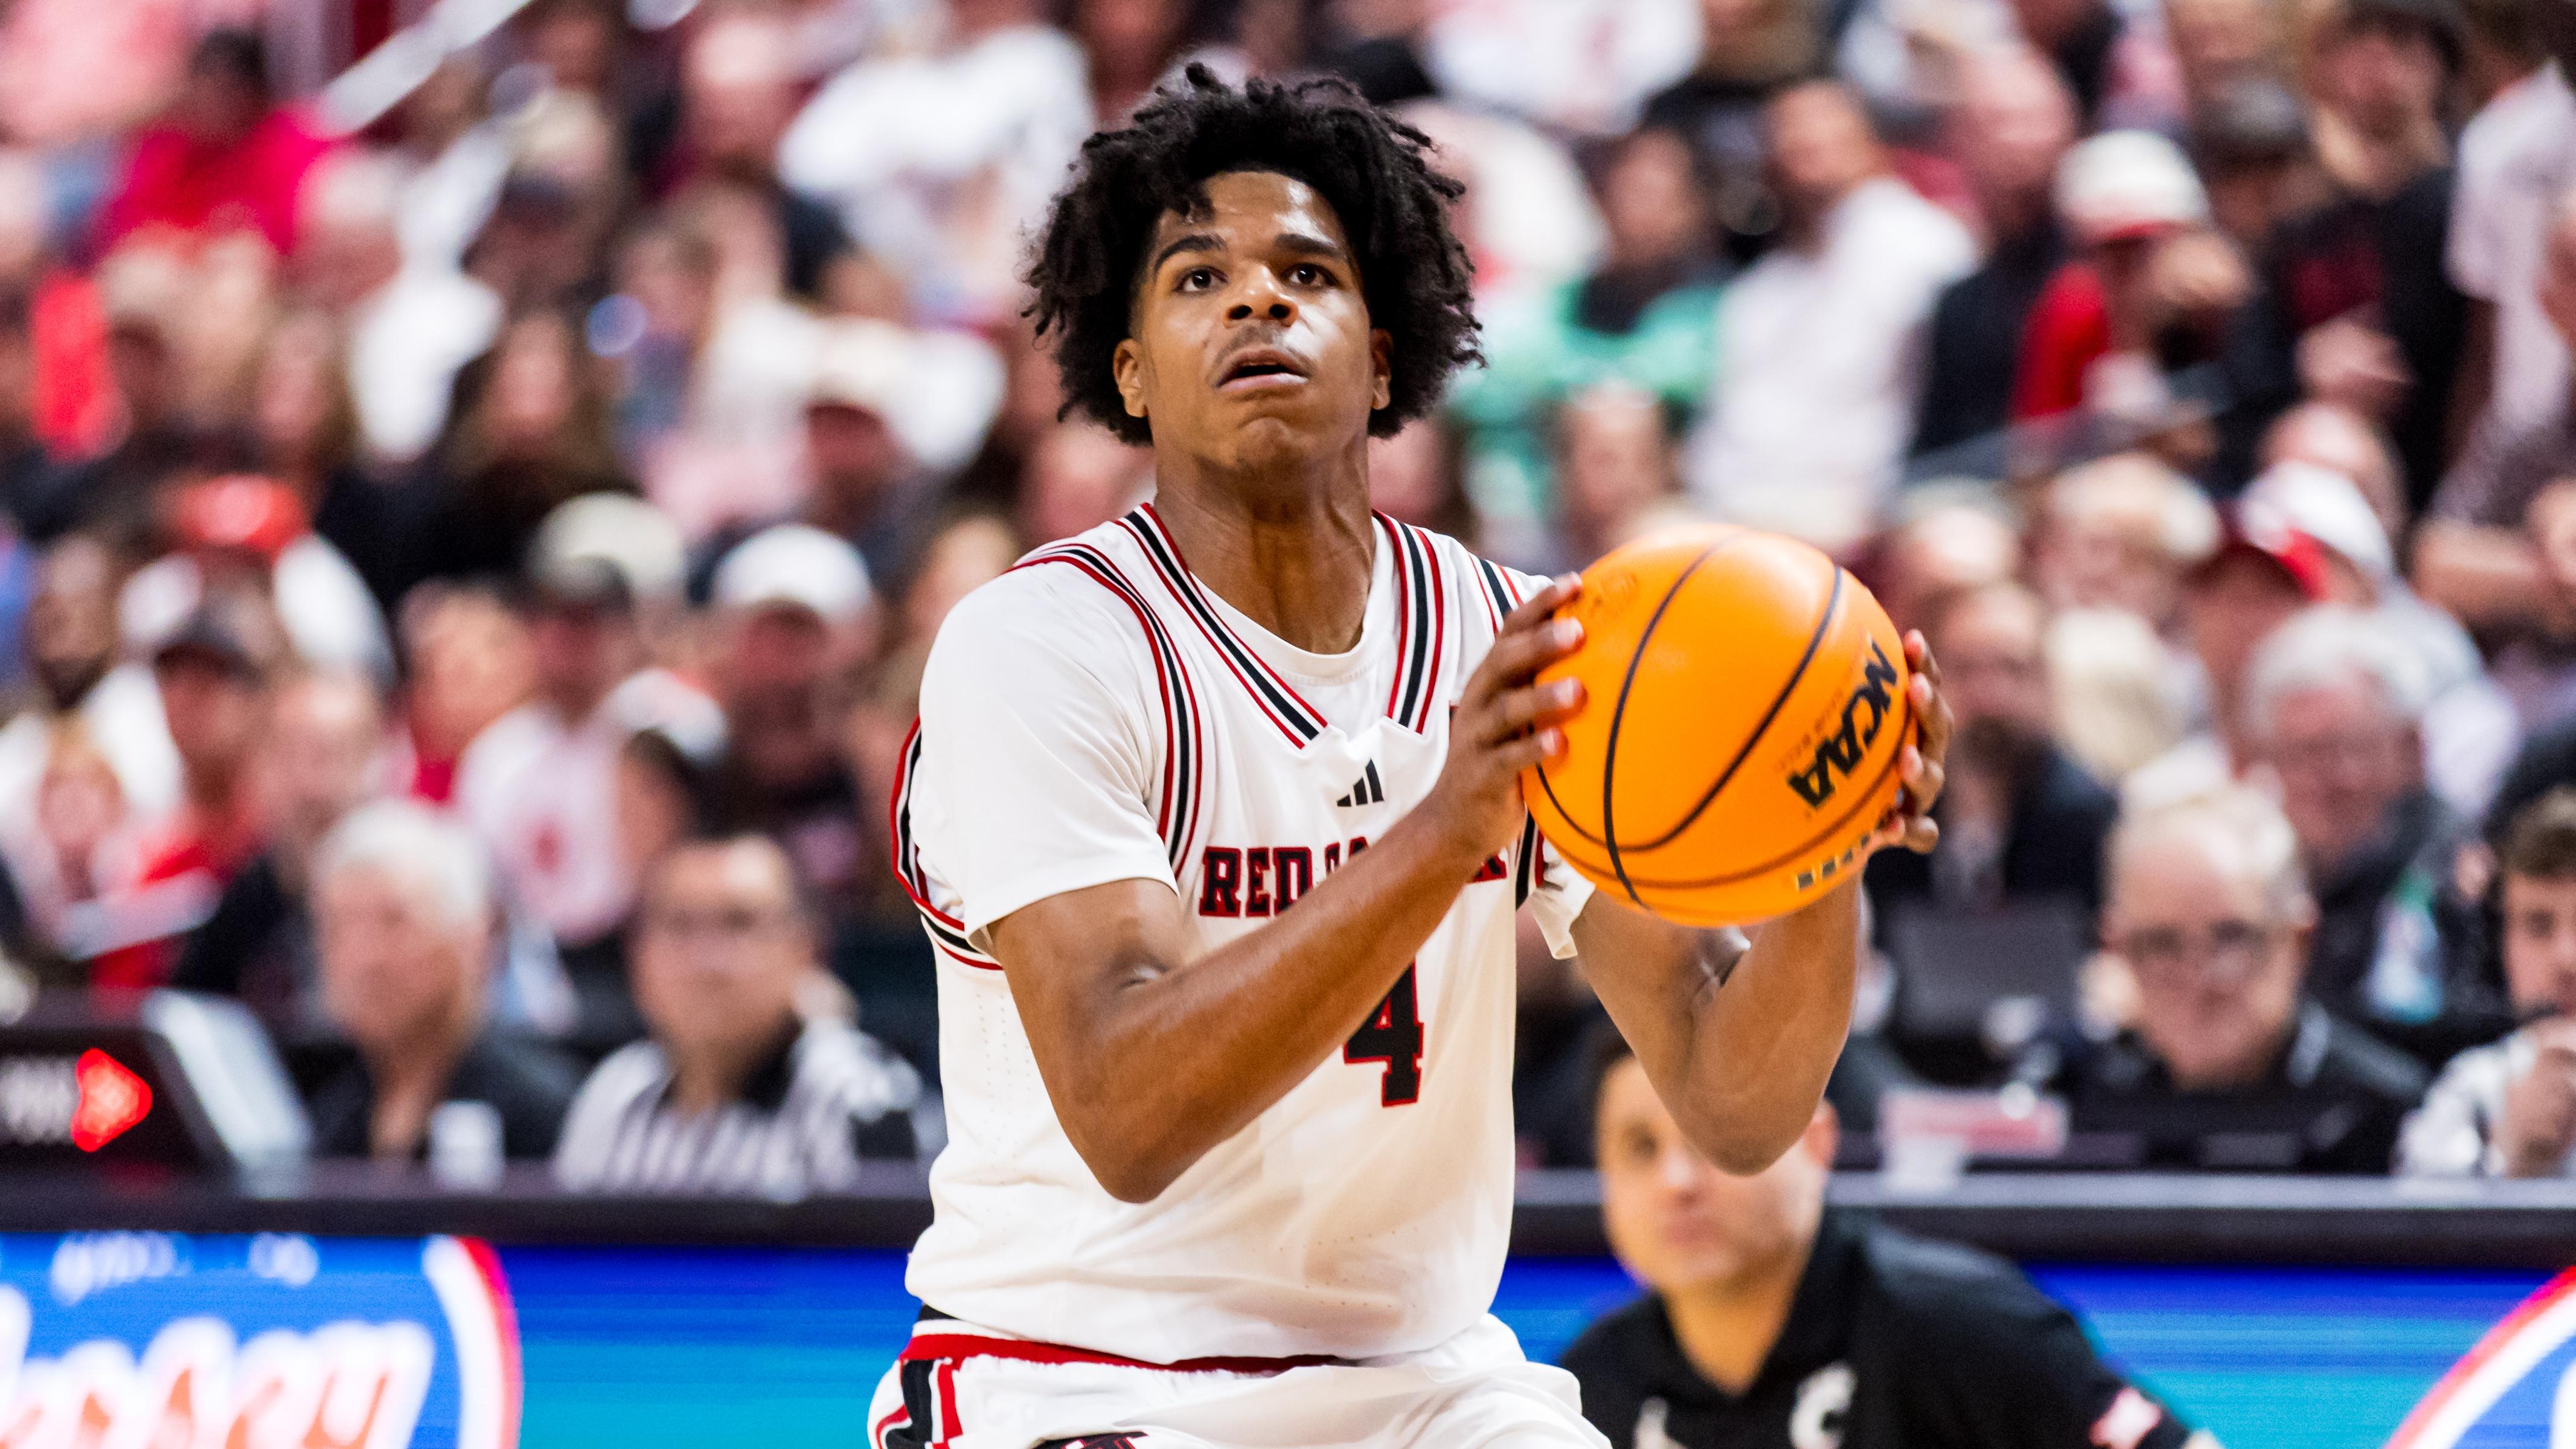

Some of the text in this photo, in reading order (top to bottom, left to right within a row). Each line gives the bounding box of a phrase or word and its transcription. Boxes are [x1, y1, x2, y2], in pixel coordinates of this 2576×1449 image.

[1786, 636, 1898, 810] NCAA
[1199, 845, 1313, 917] RED
[1342, 959, 1424, 1107] 4
